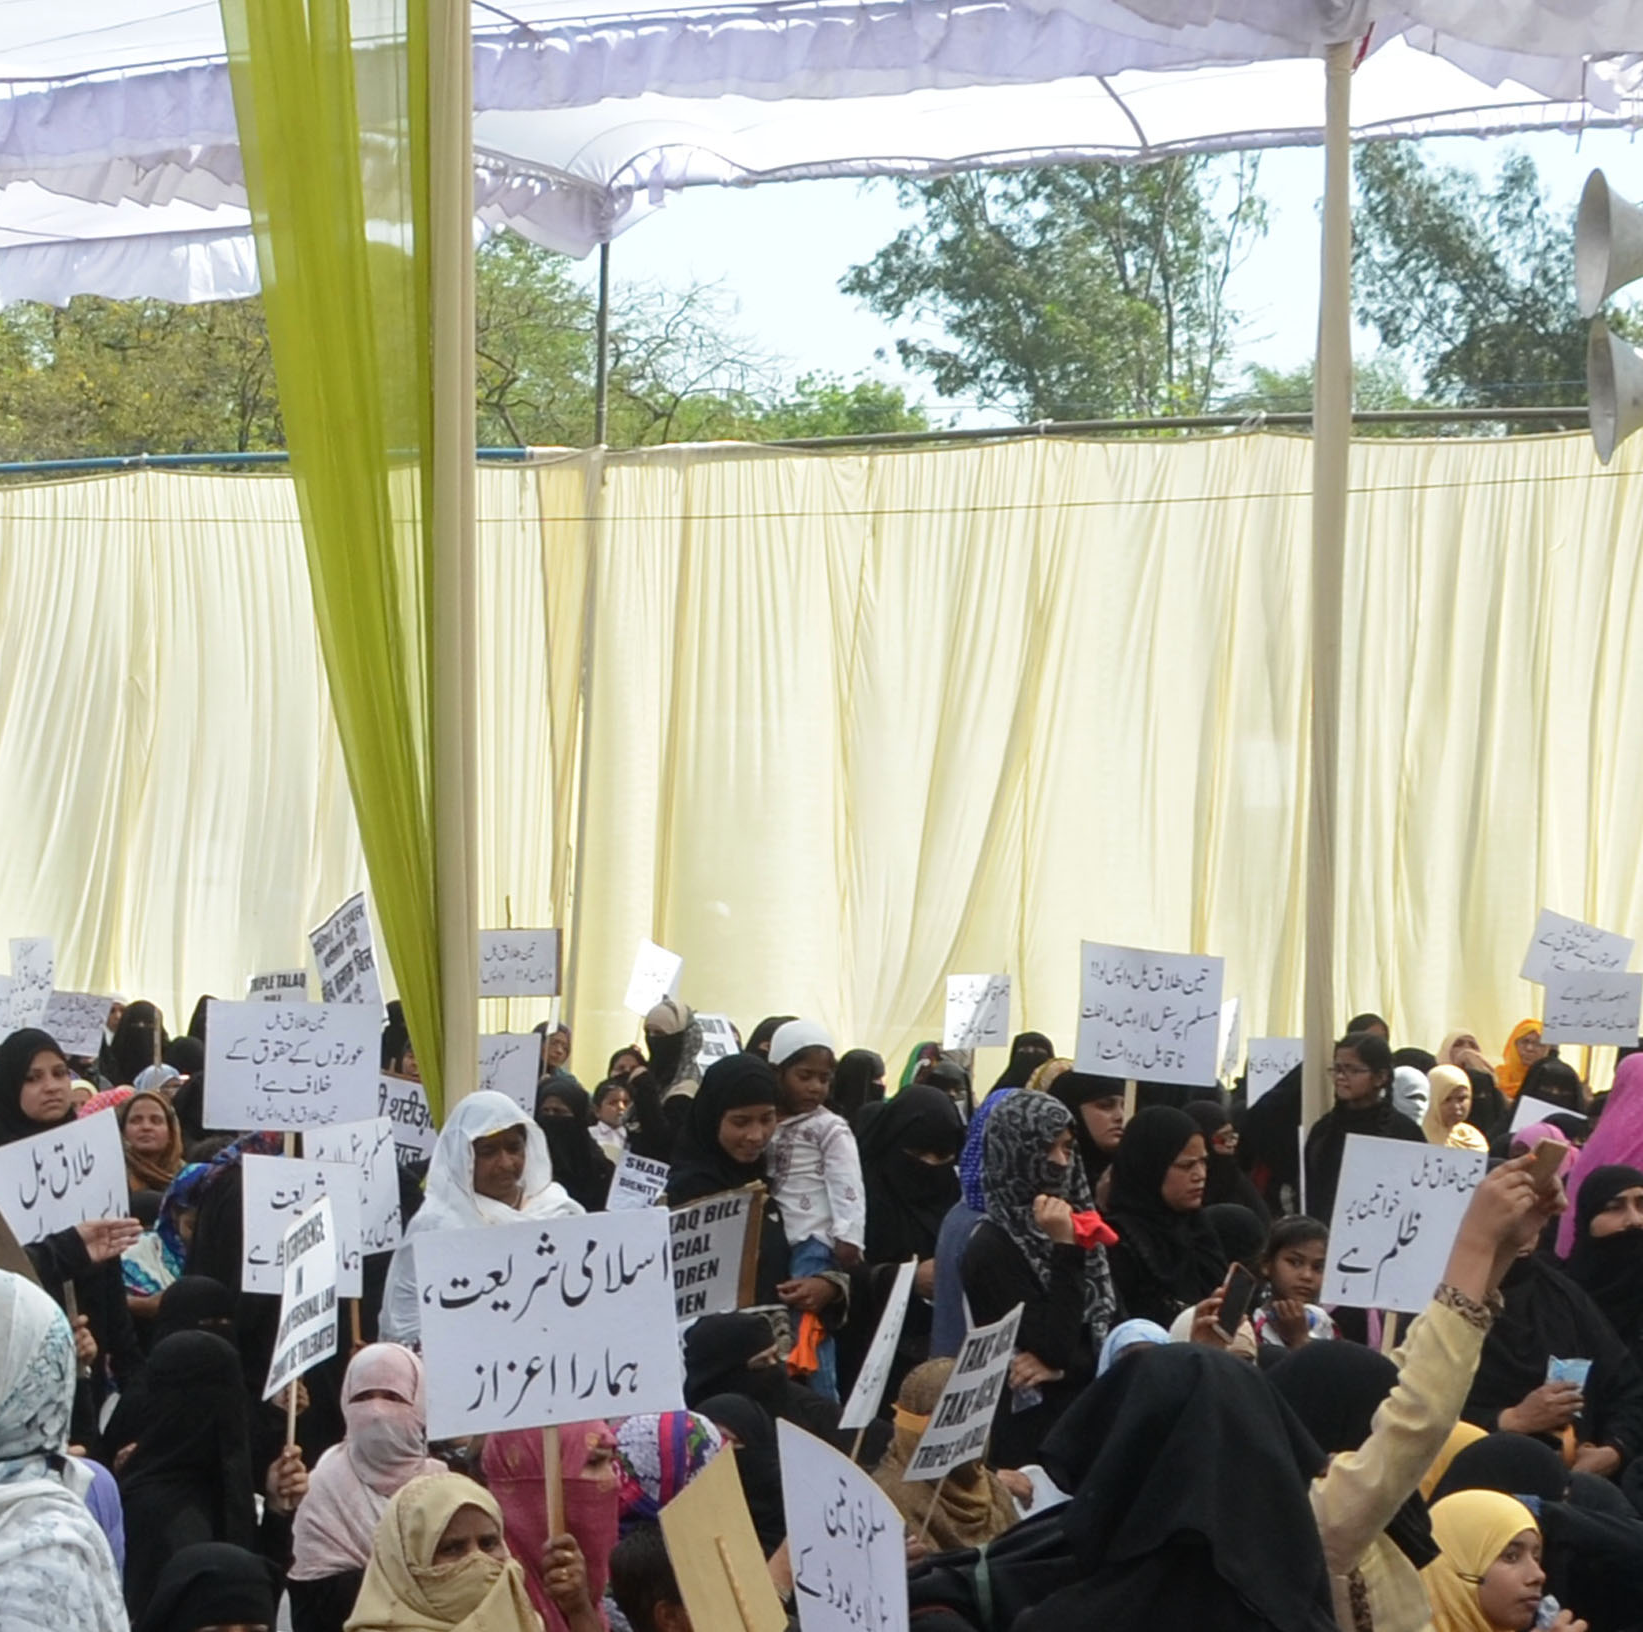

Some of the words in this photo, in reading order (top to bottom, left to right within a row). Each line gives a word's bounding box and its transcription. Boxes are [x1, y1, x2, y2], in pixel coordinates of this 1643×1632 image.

[703, 1198, 743, 1225] BILL
[466, 1354, 557, 1419] اعزاز
[570, 1348, 639, 1400] ہمارا
